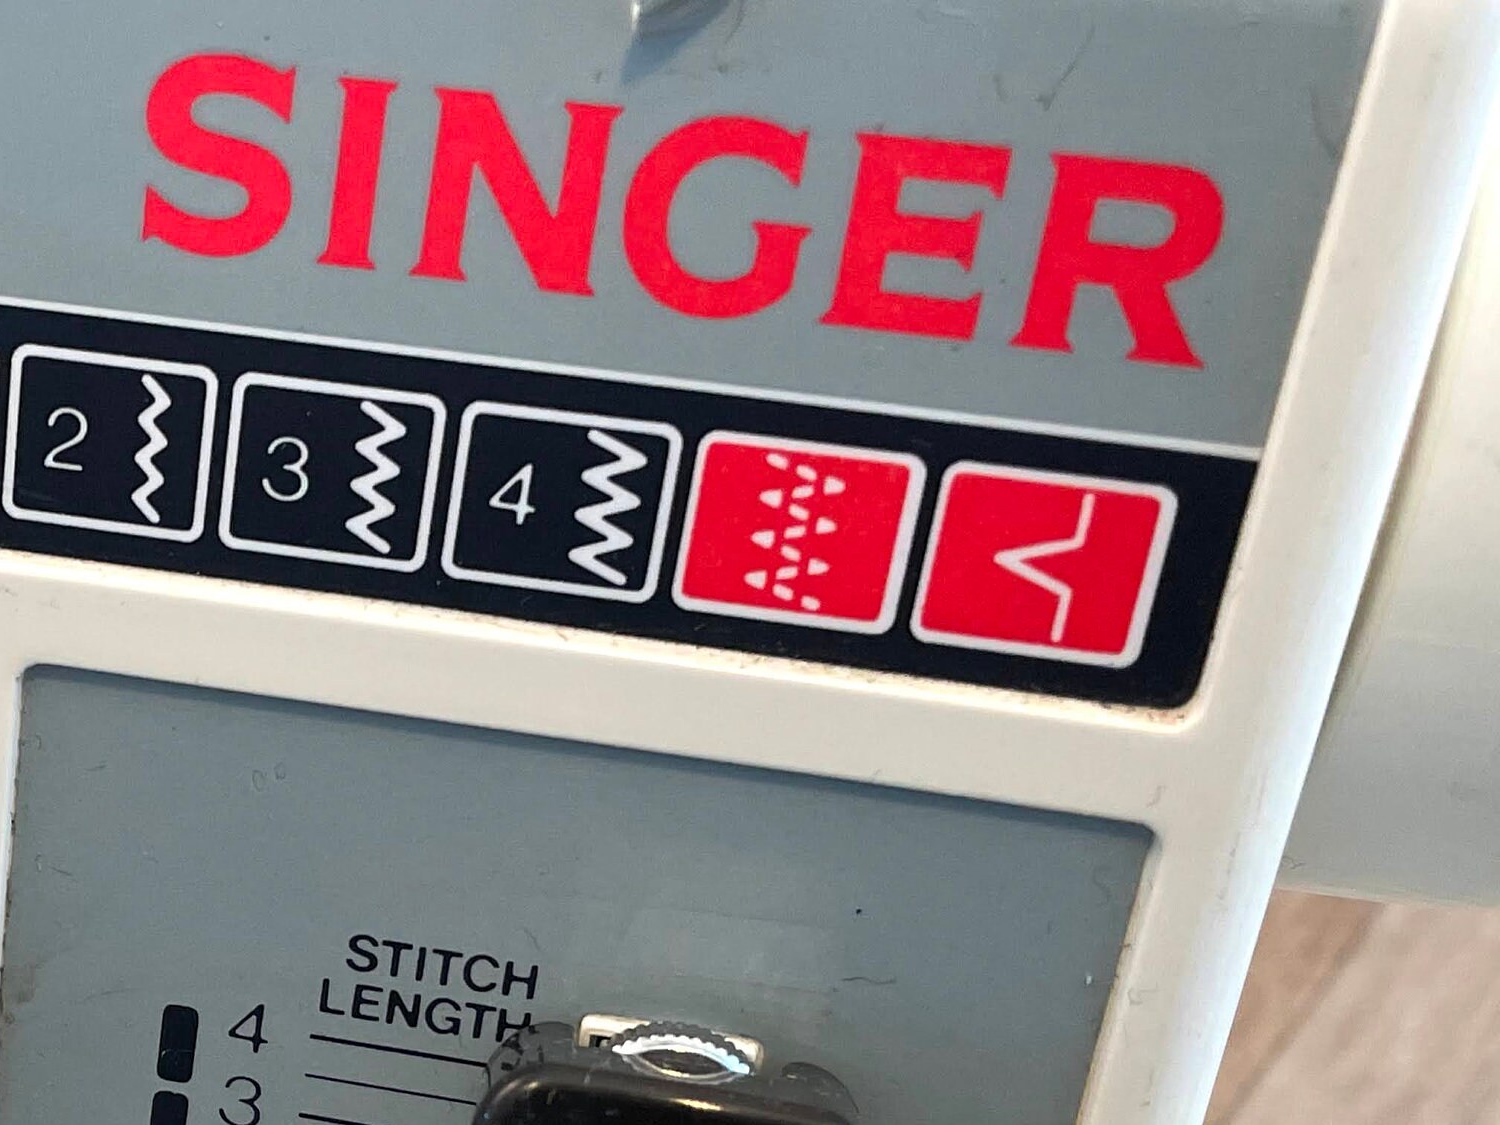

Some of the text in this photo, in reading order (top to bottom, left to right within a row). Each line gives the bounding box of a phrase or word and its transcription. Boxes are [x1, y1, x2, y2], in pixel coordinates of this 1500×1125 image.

[141, 49, 1226, 370] SINGER
[43, 407, 88, 472] 2
[261, 437, 310, 502] 3
[488, 463, 536, 526] 4
[345, 933, 540, 1000] STITCH
[228, 1003, 269, 1054] 4
[318, 978, 534, 1042] LENGTH
